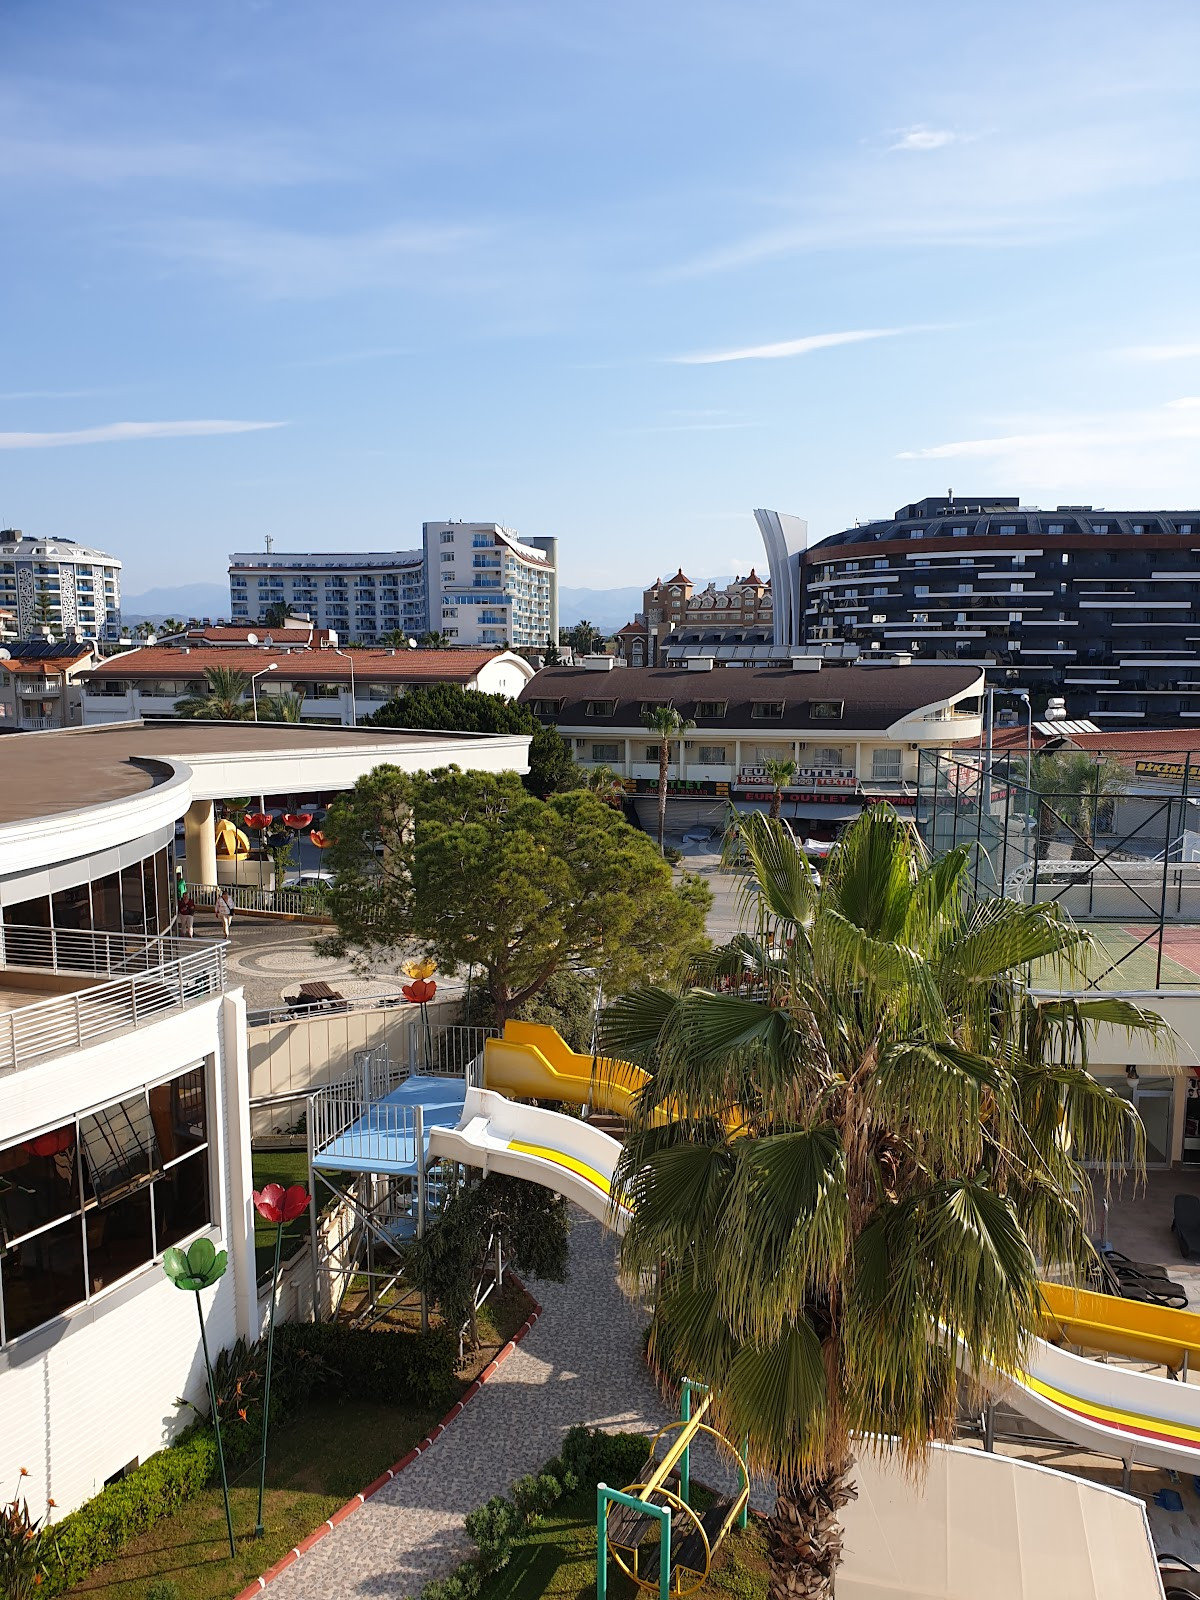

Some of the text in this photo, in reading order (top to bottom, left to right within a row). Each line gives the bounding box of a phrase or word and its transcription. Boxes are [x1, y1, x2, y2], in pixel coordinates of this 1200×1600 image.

[649, 780, 703, 790] OTLET
[741, 776, 773, 785] SHOES
[820, 778, 855, 786] TEXTIL
[790, 793, 849, 803] OUTLET
